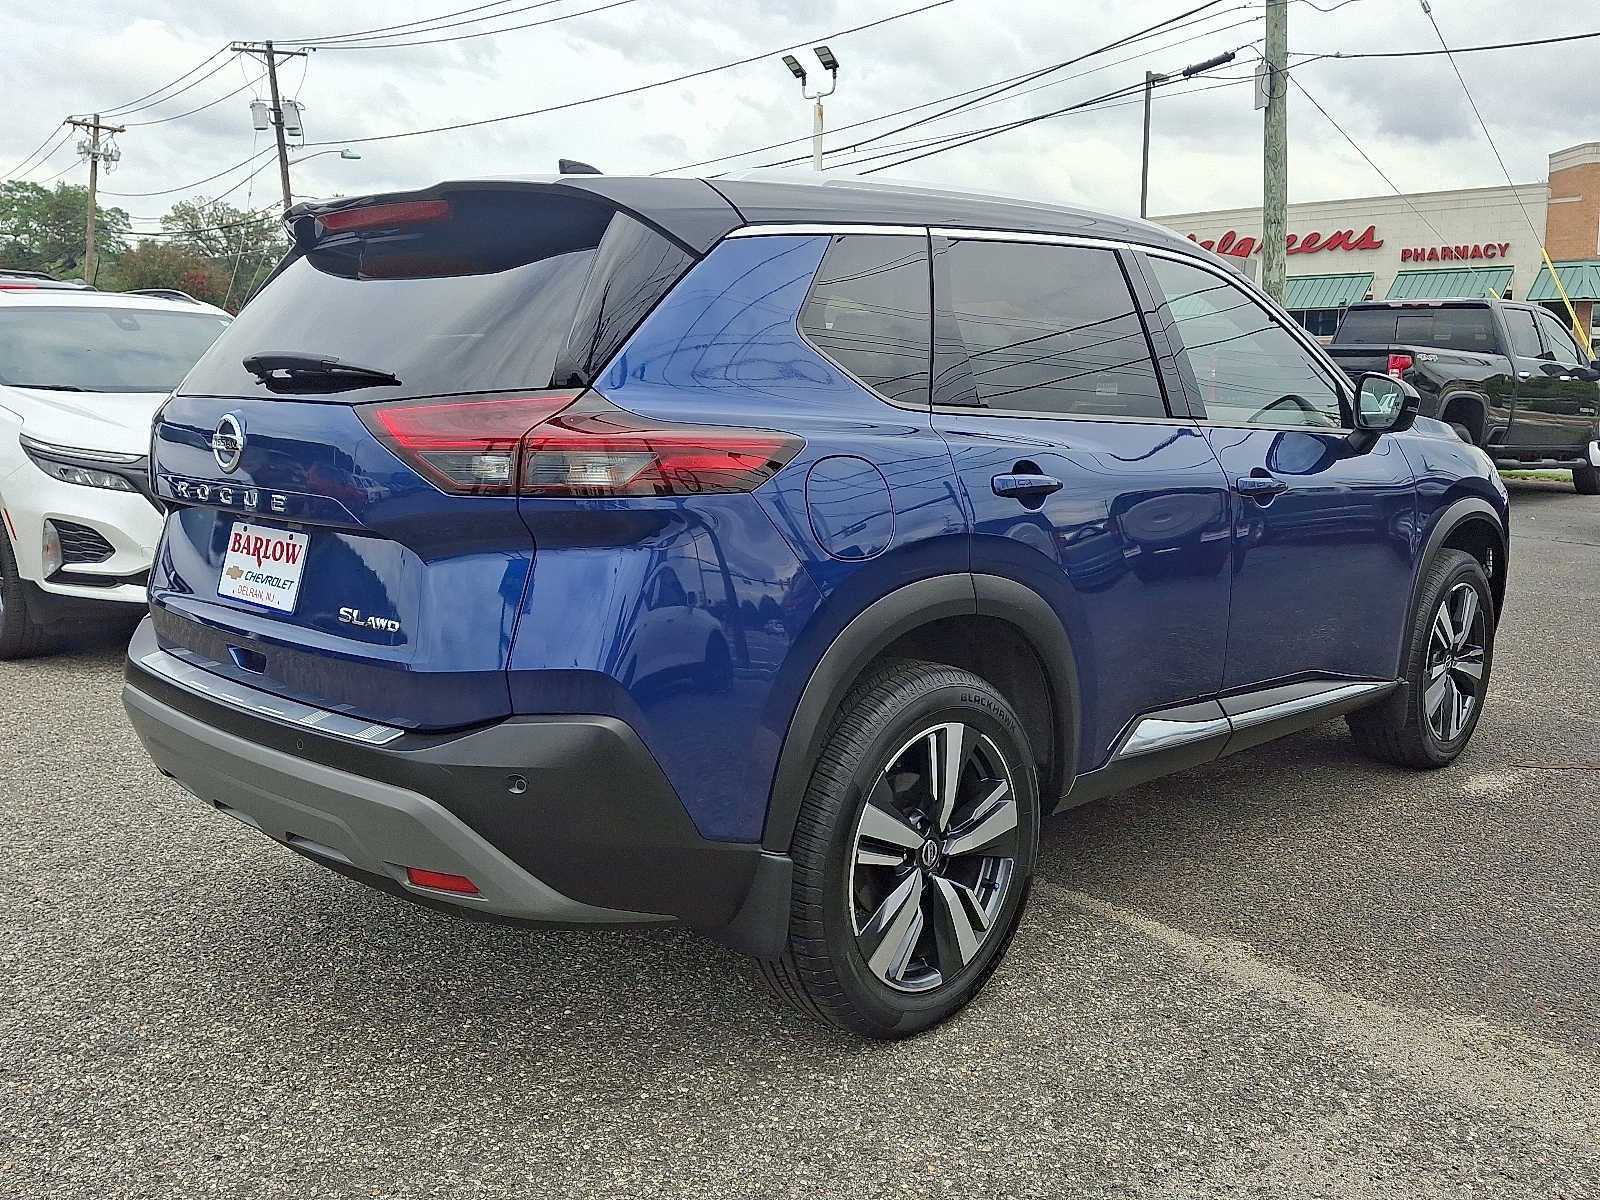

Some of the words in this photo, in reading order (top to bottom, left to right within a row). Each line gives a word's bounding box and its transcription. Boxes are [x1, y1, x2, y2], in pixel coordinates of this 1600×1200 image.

[1400, 242, 1510, 263] PHARMACY
[177, 480, 288, 512] ROGUE
[231, 532, 303, 569] BARLOW
[244, 570, 295, 591] CHEVROLET
[338, 606, 365, 626] SL
[365, 616, 400, 633] AWD
